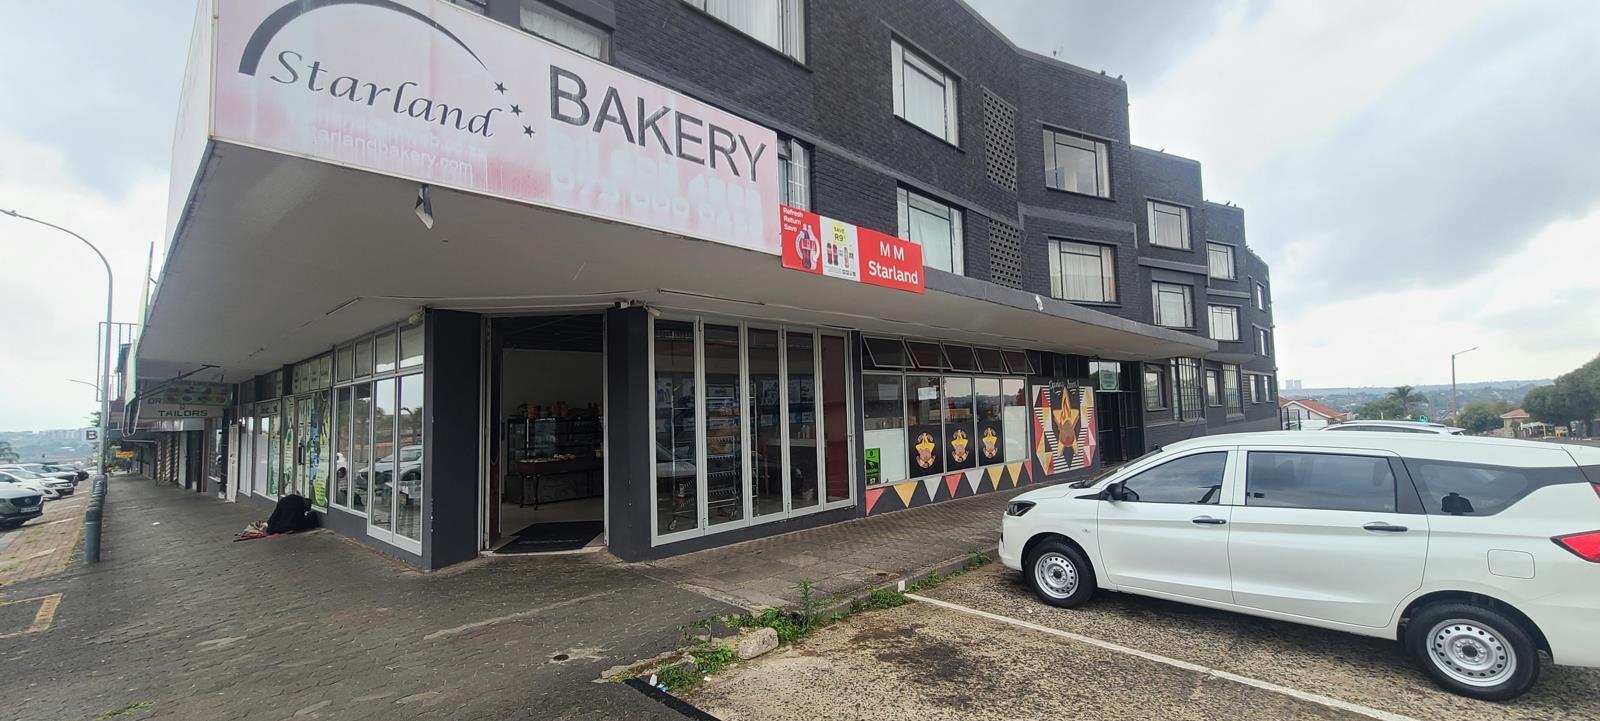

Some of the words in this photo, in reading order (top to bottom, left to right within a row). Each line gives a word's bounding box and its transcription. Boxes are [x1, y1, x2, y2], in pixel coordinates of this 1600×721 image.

[270, 50, 503, 138] Starland
[549, 64, 767, 182] BAKERY
[783, 207, 803, 218] Refresh
[783, 215, 801, 225] Return
[783, 223, 797, 232] Save
[880, 241, 890, 258] M
[893, 245, 904, 261] M
[868, 260, 918, 285] Starland
[86, 430, 98, 440] B
